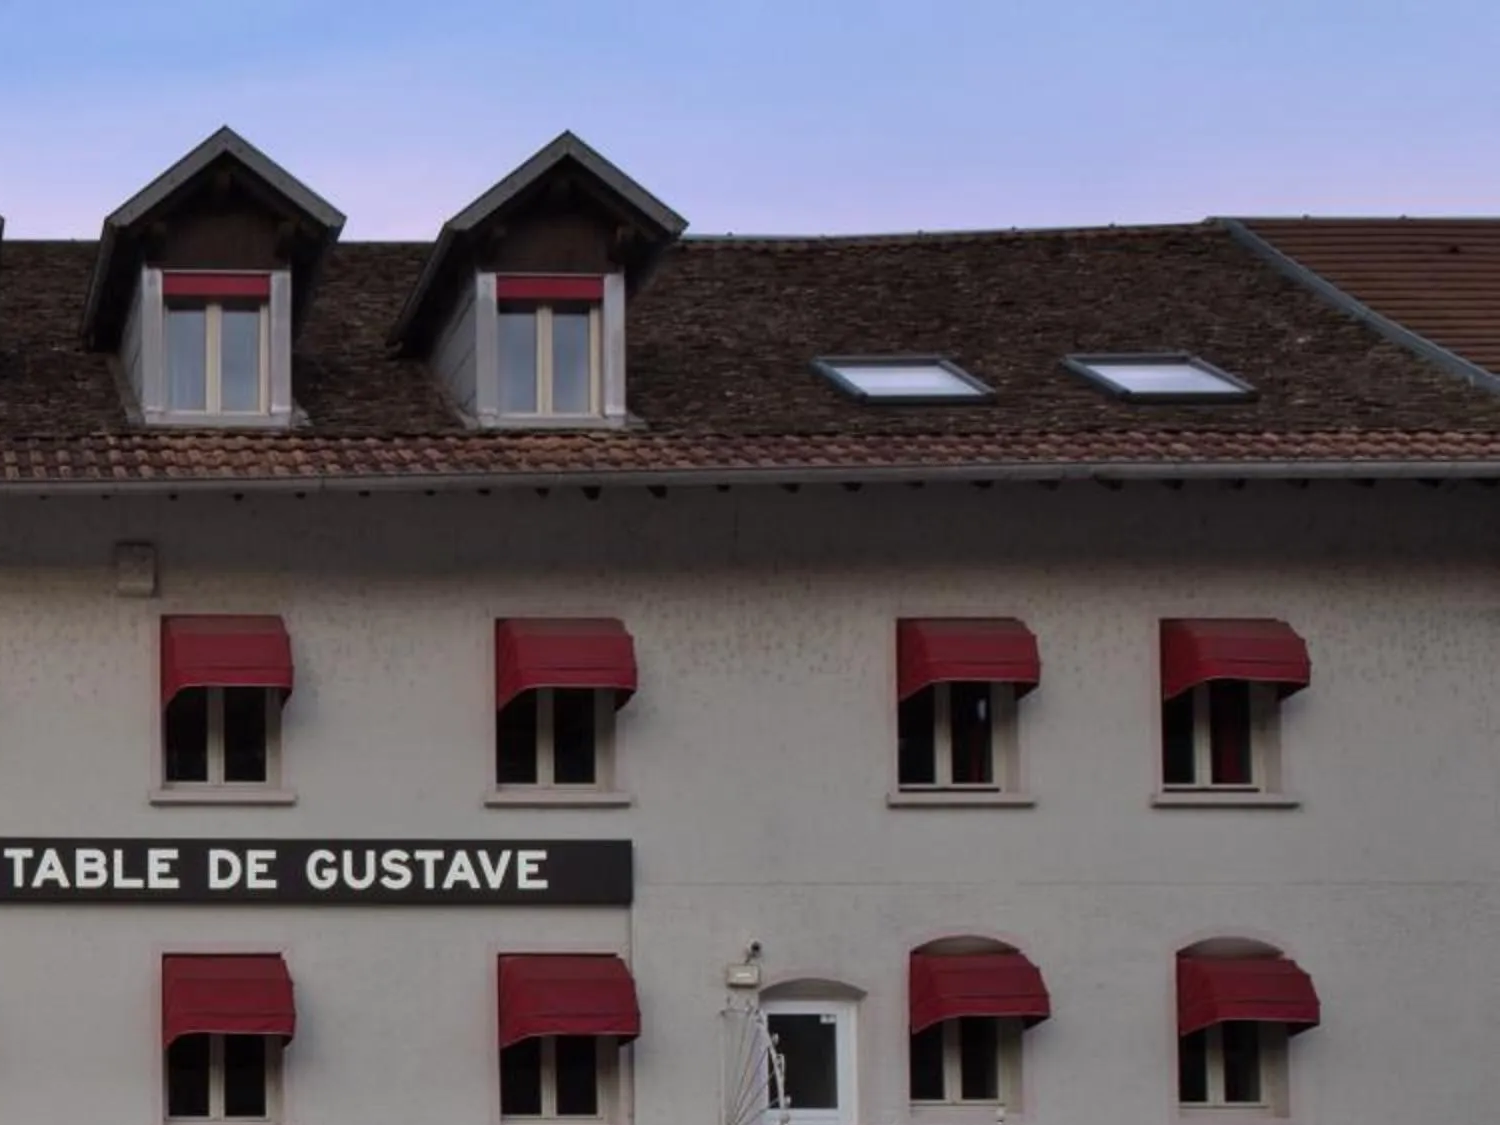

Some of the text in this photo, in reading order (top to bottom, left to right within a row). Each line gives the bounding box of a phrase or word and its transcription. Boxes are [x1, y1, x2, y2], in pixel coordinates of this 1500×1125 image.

[3, 847, 180, 889] TABLE
[208, 848, 278, 890] DE
[305, 848, 549, 891] GUSTAVE
